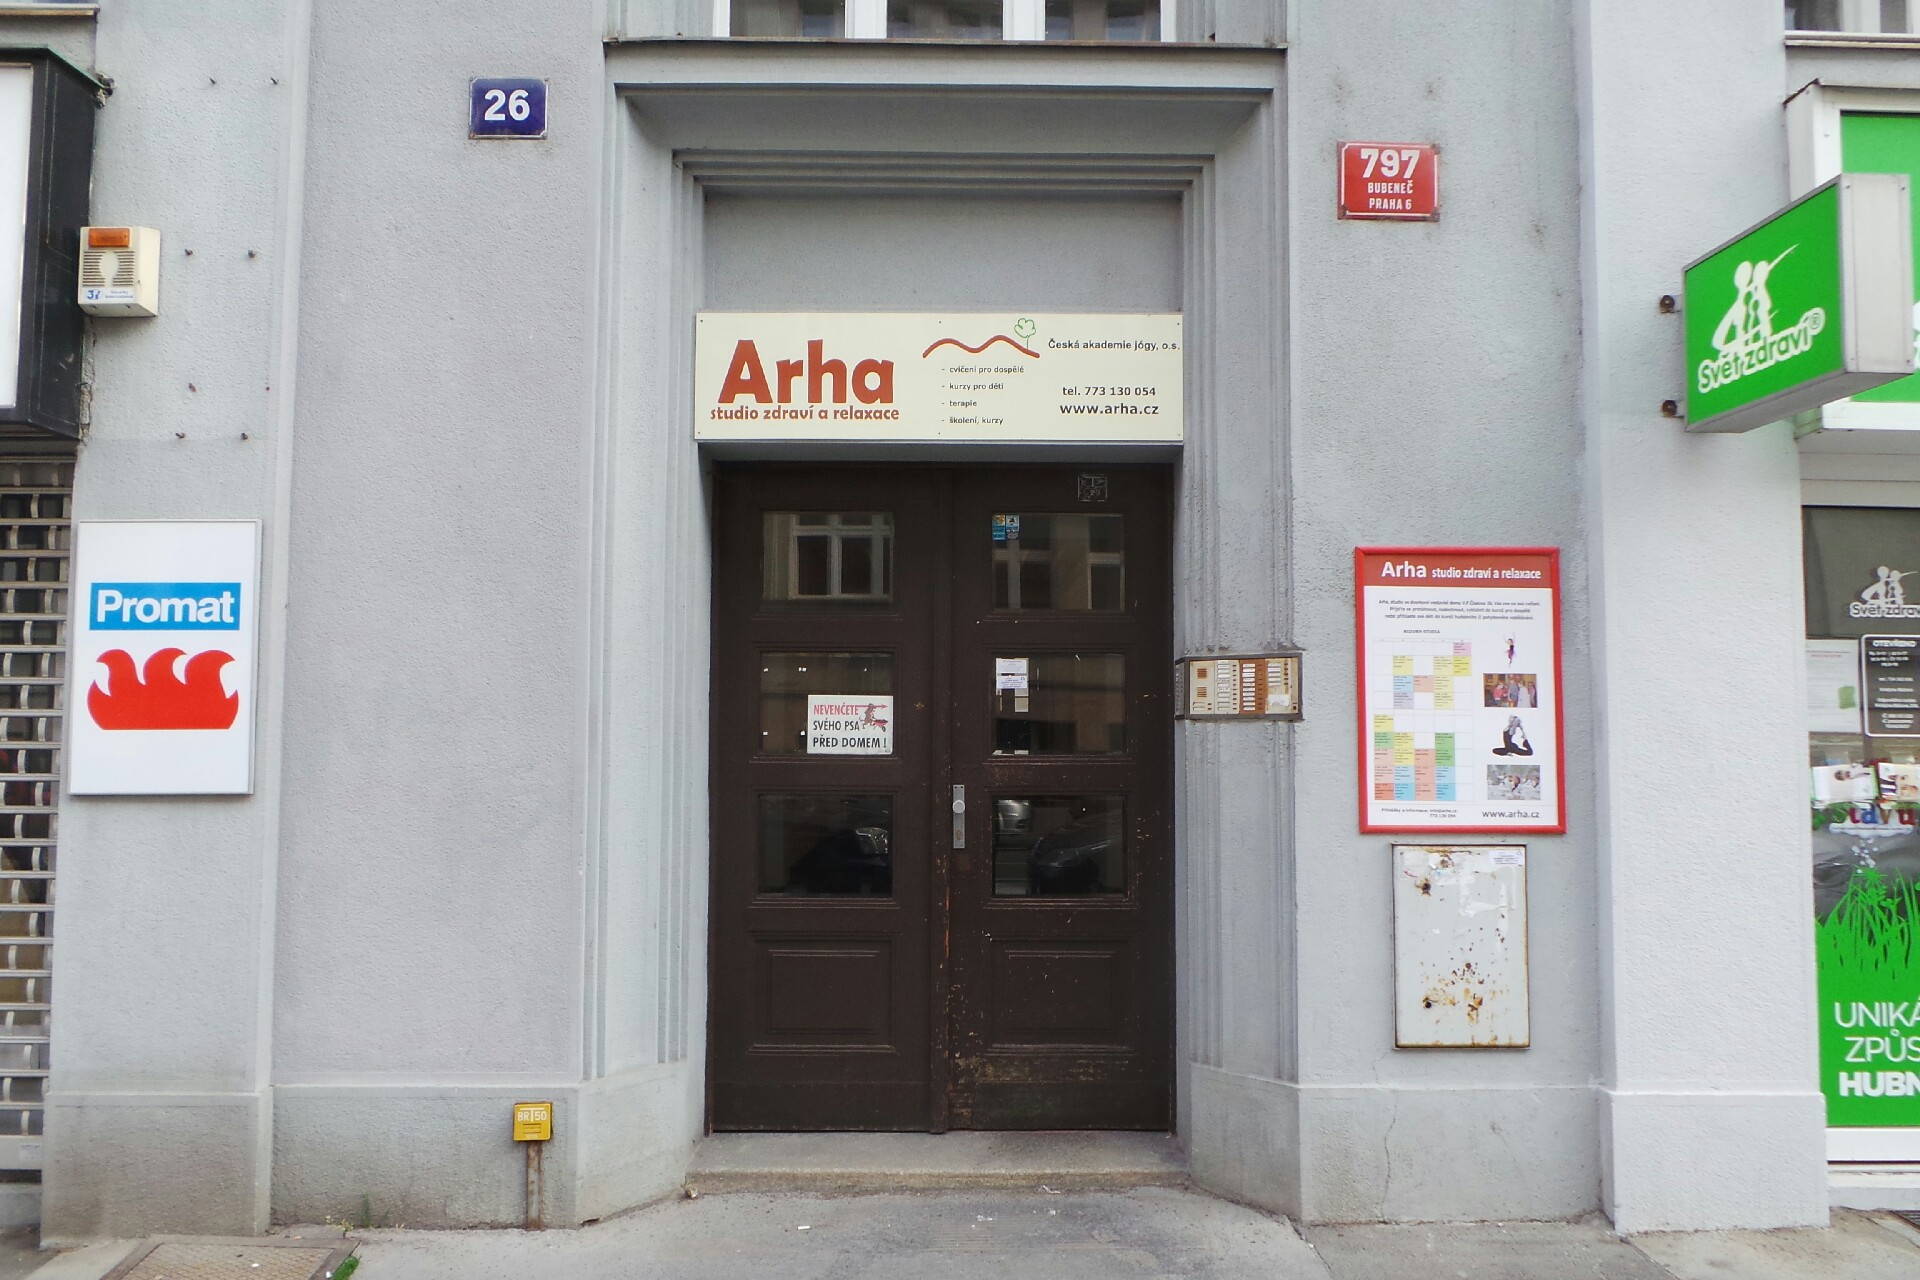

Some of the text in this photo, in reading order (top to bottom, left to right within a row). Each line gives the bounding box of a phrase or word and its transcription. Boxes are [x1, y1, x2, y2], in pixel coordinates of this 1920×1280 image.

[484, 89, 530, 121] 26
[1360, 148, 1420, 179] 797
[1367, 180, 1414, 194] BUBENEČ
[1369, 198, 1412, 210] PRAHA 6
[1048, 338, 1181, 352] Česká akademie jógy, o.s.
[1699, 315, 1810, 391] Svět zdraví
[717, 338, 894, 404] Arha
[949, 365, 1024, 375] cvičení pro dospělé
[949, 382, 1004, 391] kurzy pro děti
[1062, 386, 1156, 396] tel. 773 130 054
[949, 399, 978, 408] terapie
[1059, 403, 1160, 415] www.arha.cz
[711, 404, 900, 420] studio zdraví a relaxace
[949, 416, 1004, 425] školení, kurzy
[1381, 561, 1542, 579] Arha studio zdraví a relaxace
[97, 589, 235, 623] Promat
[1852, 603, 1881, 615] Svět
[813, 702, 859, 716] NEVENČETE
[813, 718, 860, 731] SVÉHO PSA
[813, 734, 838, 747] PŘED
[842, 738, 880, 748] DOMEM
[1482, 810, 1541, 819] www.arha.cz
